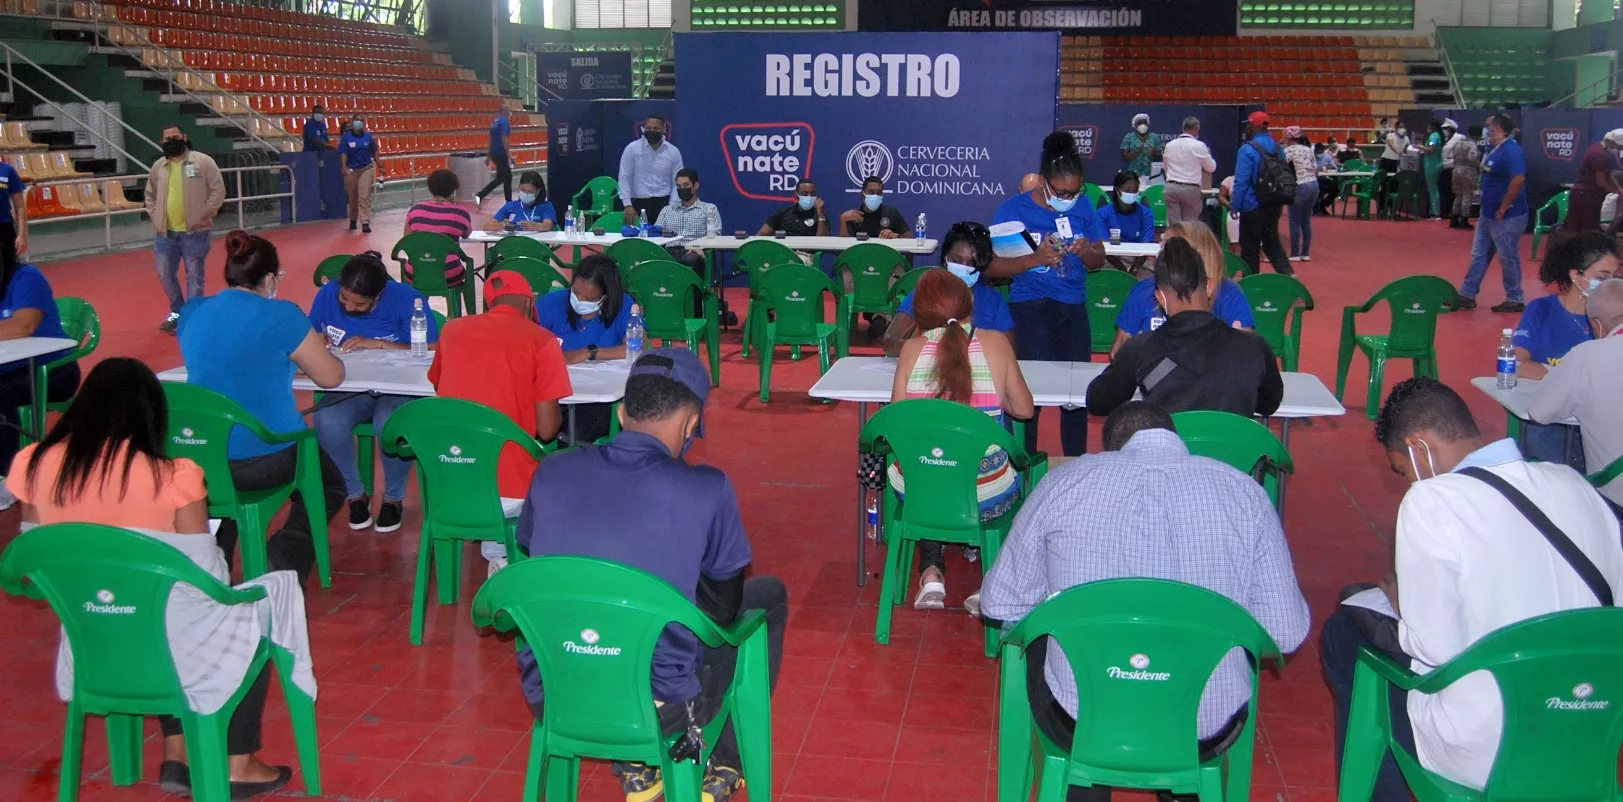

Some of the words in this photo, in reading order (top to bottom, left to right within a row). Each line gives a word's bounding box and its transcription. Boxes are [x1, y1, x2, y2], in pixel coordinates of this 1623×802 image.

[947, 7, 990, 27] ÁREA
[995, 9, 1016, 27] DE
[1020, 7, 1142, 28] OBSERVACIÓN
[571, 57, 599, 67] SALIDA
[765, 53, 960, 98] REGISTRO
[735, 129, 800, 151] vacú
[1546, 131, 1574, 140] vacú
[1078, 146, 1092, 154] RD
[1546, 140, 1573, 149] nate
[897, 145, 990, 160] CERVECERIA
[738, 152, 800, 172] nate
[898, 163, 981, 178] NACIONAL
[769, 174, 800, 191] RD
[897, 180, 1005, 196] DOMINICANA
[438, 454, 477, 464] Presidente
[919, 456, 958, 467] Presidente
[83, 601, 137, 614] Presidente
[563, 640, 622, 656] Presidente
[1106, 666, 1171, 681] Presidente
[1545, 697, 1609, 710] Presidente
